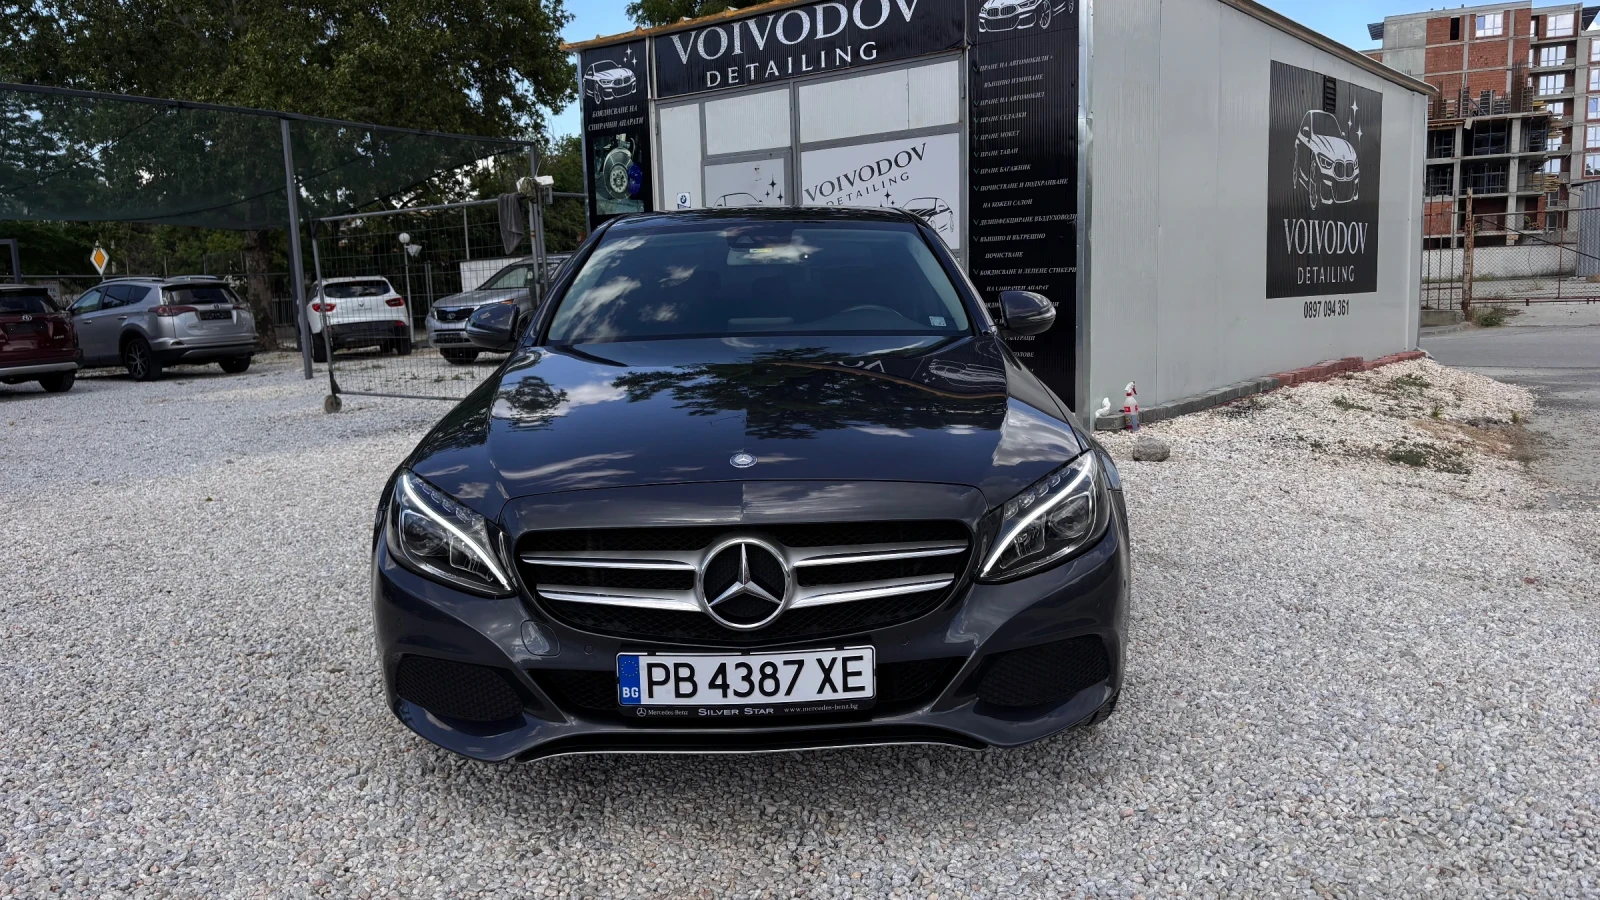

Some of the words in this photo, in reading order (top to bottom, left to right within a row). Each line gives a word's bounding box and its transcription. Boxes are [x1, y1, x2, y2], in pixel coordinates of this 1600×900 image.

[670, 0, 919, 65] VOIVODOV
[706, 41, 878, 87] DETAILING
[804, 142, 926, 202] VOIVODOV
[826, 172, 910, 206] DETAILING
[1283, 218, 1368, 254] VOIVODOV
[1297, 265, 1355, 284] DETAILING
[1304, 300, 1322, 318] 0897
[1323, 299, 1336, 317] 094
[1337, 299, 1350, 316] 361
[622, 687, 639, 698] BG
[646, 662, 698, 699] PB
[708, 659, 805, 699] 4387
[815, 655, 866, 694] XE
[784, 703, 858, 713] www.mercedes-benz.bg
